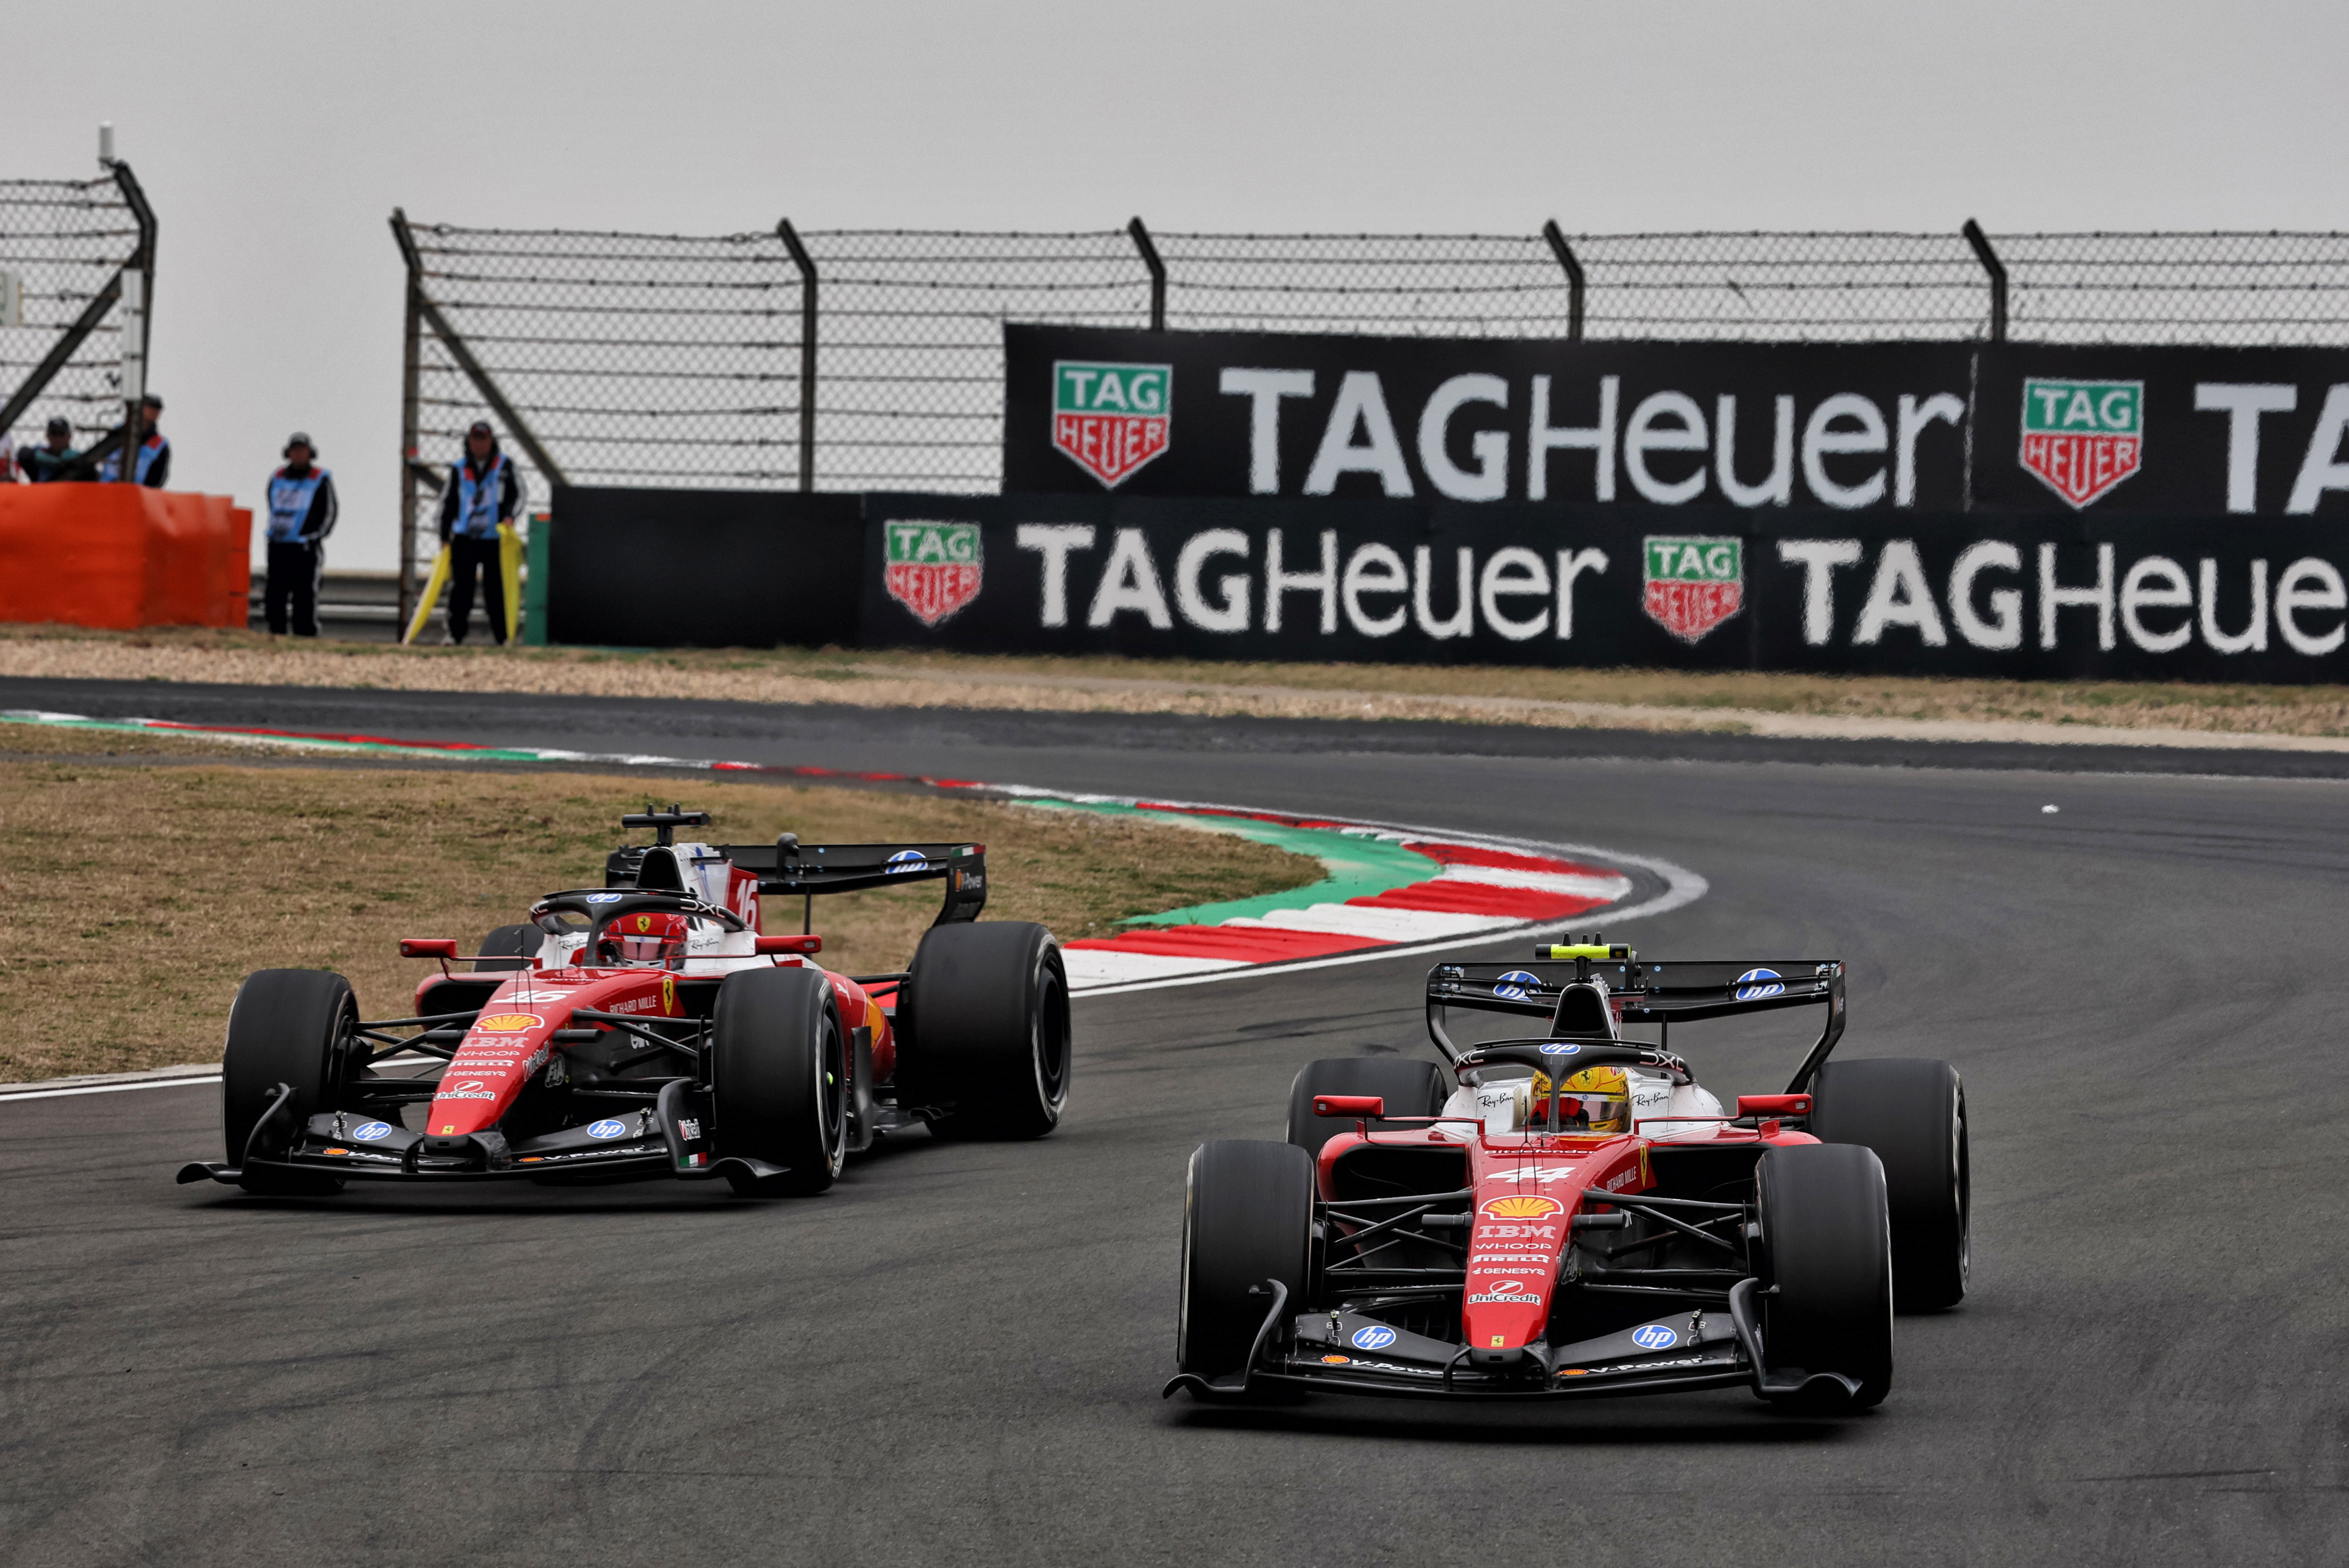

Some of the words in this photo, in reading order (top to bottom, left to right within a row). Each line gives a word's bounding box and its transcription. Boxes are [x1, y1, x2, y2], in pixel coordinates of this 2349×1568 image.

[1065, 370, 1159, 410] TAG
[2034, 387, 2132, 428] TAG
[1059, 418, 1162, 475] HEUER
[2028, 438, 2133, 497] HEUER
[895, 528, 972, 562] TAG
[1654, 545, 1732, 577] TAG
[891, 567, 975, 613] HEUER
[736, 878, 758, 930] 16
[491, 990, 577, 1003] 16
[460, 1037, 530, 1048] IBM
[1544, 1043, 1576, 1054] hp
[1639, 1052, 1685, 1072] DXC
[434, 1090, 496, 1101] UniCredit
[357, 1122, 389, 1140] hp
[591, 1119, 622, 1139] hp
[1485, 1166, 1577, 1183] 44
[1606, 1172, 1624, 1192] RICHARD
[1624, 1166, 1637, 1183] MILLE
[1477, 1225, 1556, 1239] IBM
[1472, 1254, 1550, 1264] PIRELLI
[1468, 1293, 1541, 1306] UniCredit
[1355, 1326, 1392, 1350] hp
[1637, 1325, 1673, 1349] hp
[1351, 1359, 1444, 1375] V-Powe
